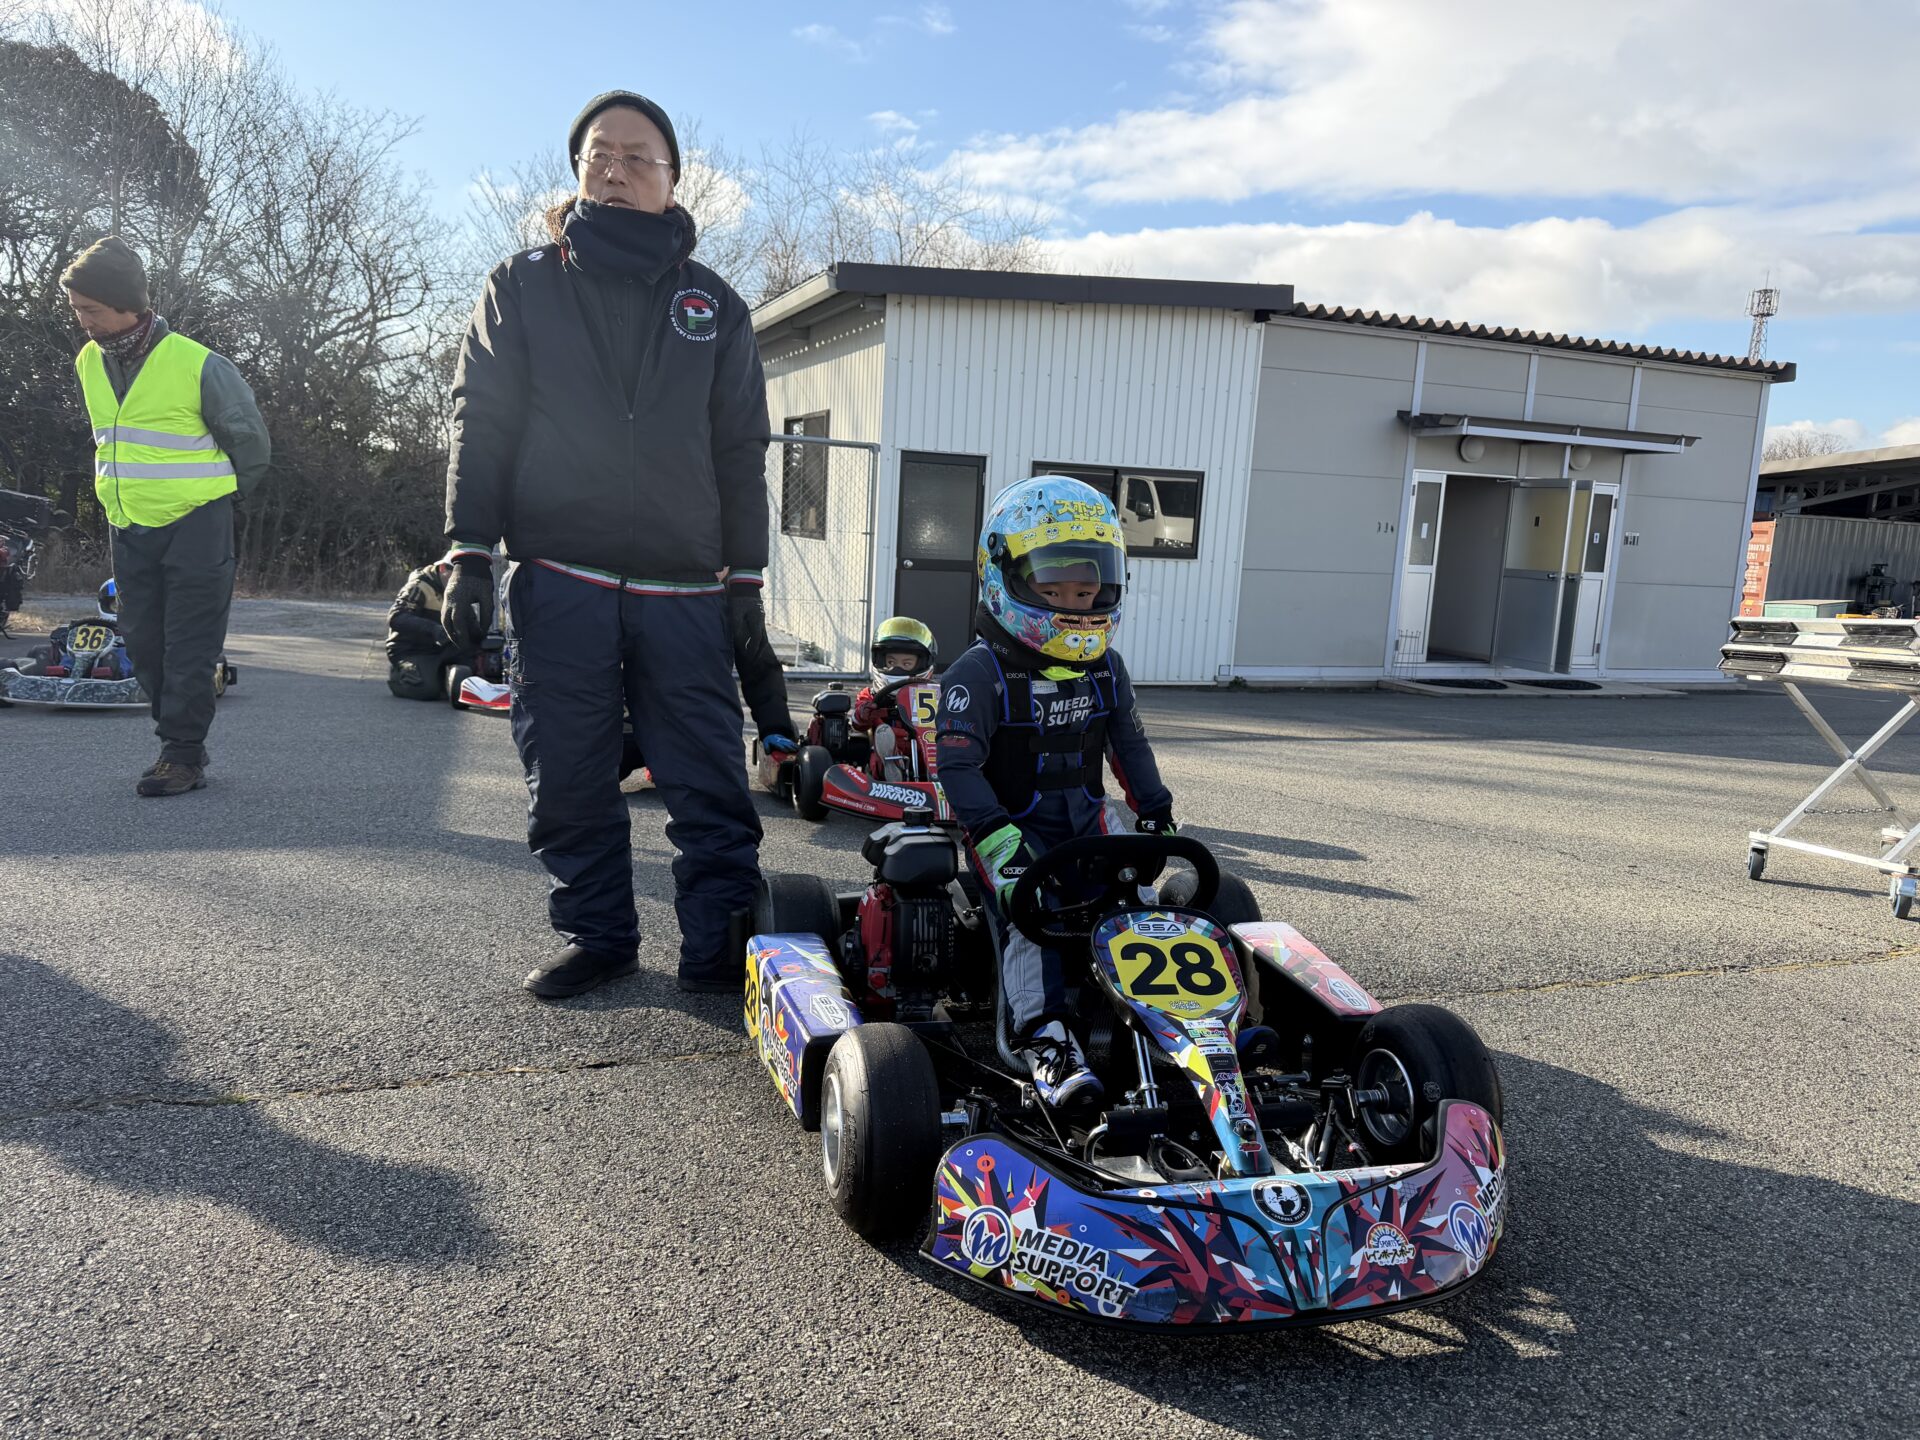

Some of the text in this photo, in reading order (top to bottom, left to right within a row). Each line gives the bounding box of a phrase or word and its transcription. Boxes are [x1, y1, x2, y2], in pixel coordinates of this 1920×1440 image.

[75, 628, 104, 649] 36
[918, 692, 936, 724] 5
[871, 782, 927, 801] MISSION
[1137, 923, 1181, 932] BSA
[1120, 942, 1227, 996] 28
[1369, 1225, 1407, 1248] RAINBOW
[1018, 1228, 1109, 1273] MEDIA
[1013, 1250, 1138, 1305] SUPPORT
